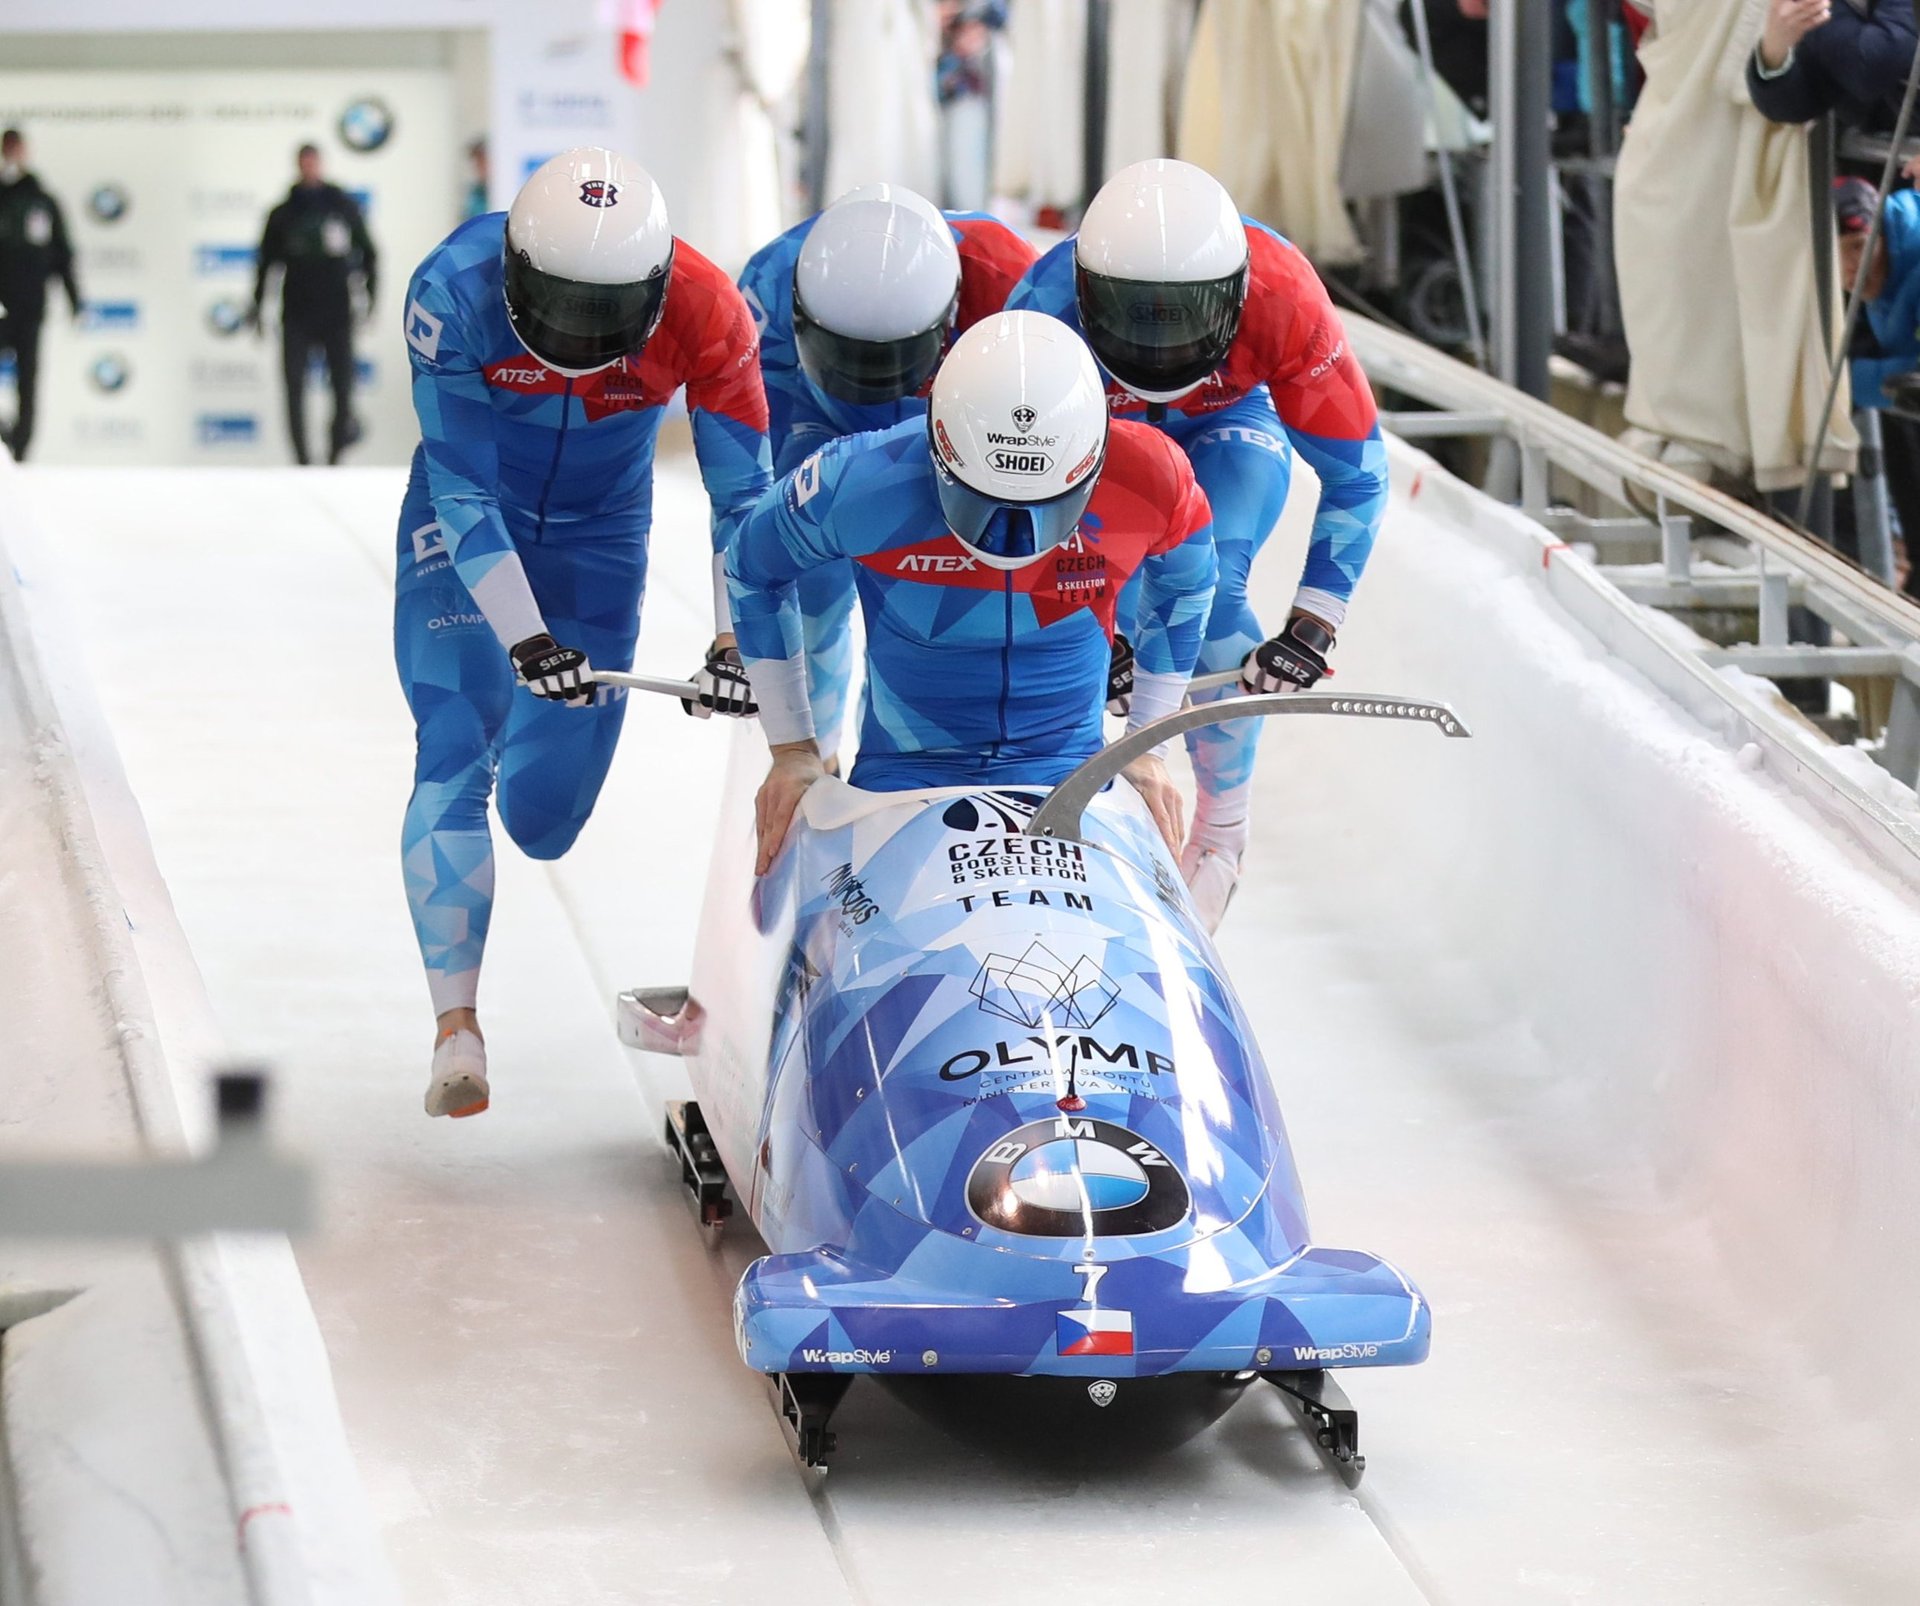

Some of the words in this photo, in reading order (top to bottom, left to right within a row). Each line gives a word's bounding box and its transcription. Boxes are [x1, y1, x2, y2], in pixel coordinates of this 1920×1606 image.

[1135, 305, 1183, 322] SHOEI
[491, 368, 549, 385] ATEX
[1105, 392, 1140, 408] TEX
[986, 431, 1056, 448] WrapStyle
[995, 453, 1046, 473] SHOEI
[896, 554, 977, 572] ATEX
[1056, 554, 1106, 573] CZECH
[1065, 577, 1106, 590] SKELETON
[1056, 588, 1105, 603] TEAM
[427, 614, 488, 629] OLYMP
[539, 651, 576, 671] SEIZ
[1272, 655, 1311, 683] SEIZ
[948, 838, 1084, 862] CZECH
[950, 855, 1086, 874] BOBSLEIGH
[952, 873, 966, 884] &
[974, 866, 1087, 883] SKELETON
[956, 889, 1094, 914] TEAM
[939, 1034, 1175, 1082] OLYMP
[1080, 1068, 1151, 1088] SPORTU
[984, 1120, 1170, 1168] BMW
[1072, 1264, 1109, 1302] 7
[802, 1349, 891, 1365] WrapStyle
[1293, 1343, 1378, 1361] WrapStyle
